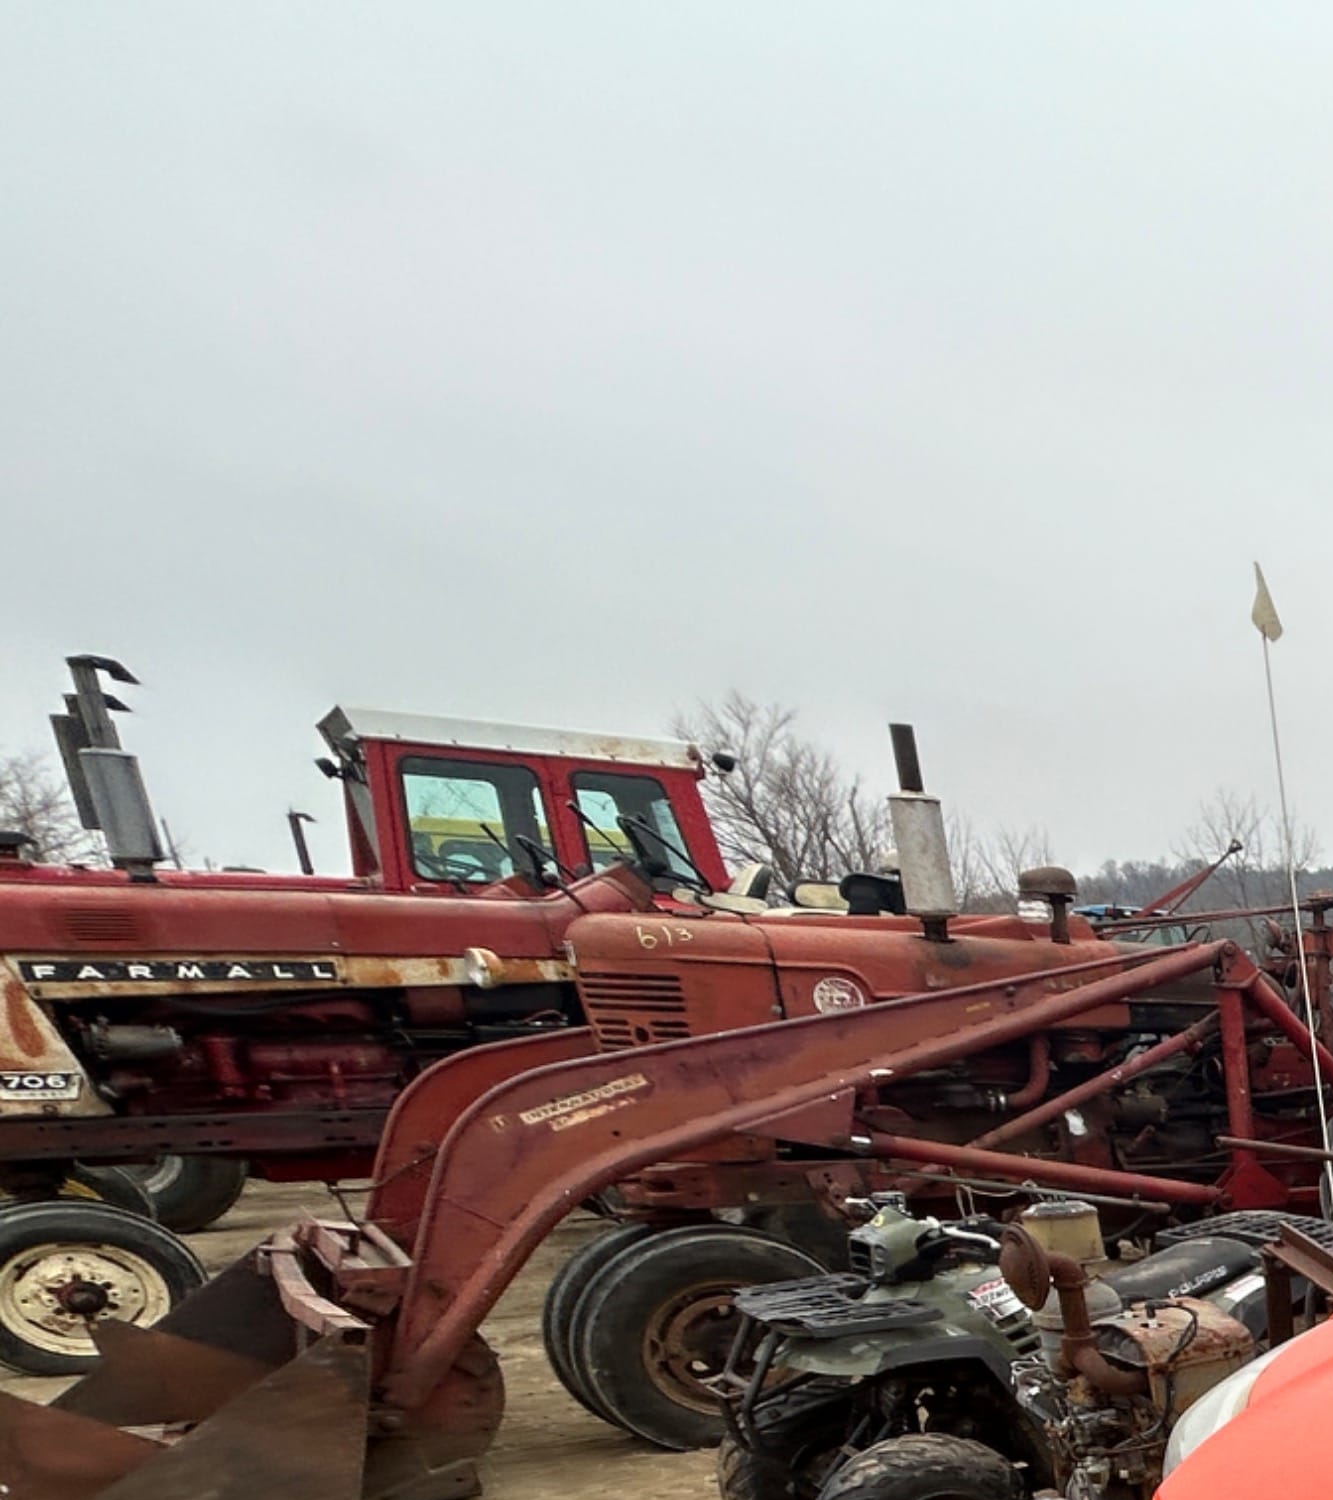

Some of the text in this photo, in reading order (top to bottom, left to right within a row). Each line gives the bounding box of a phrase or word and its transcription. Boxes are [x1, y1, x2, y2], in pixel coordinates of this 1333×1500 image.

[636, 926, 694, 949] 613
[31, 963, 334, 981] FARMALL
[3, 1074, 67, 1089] 706
